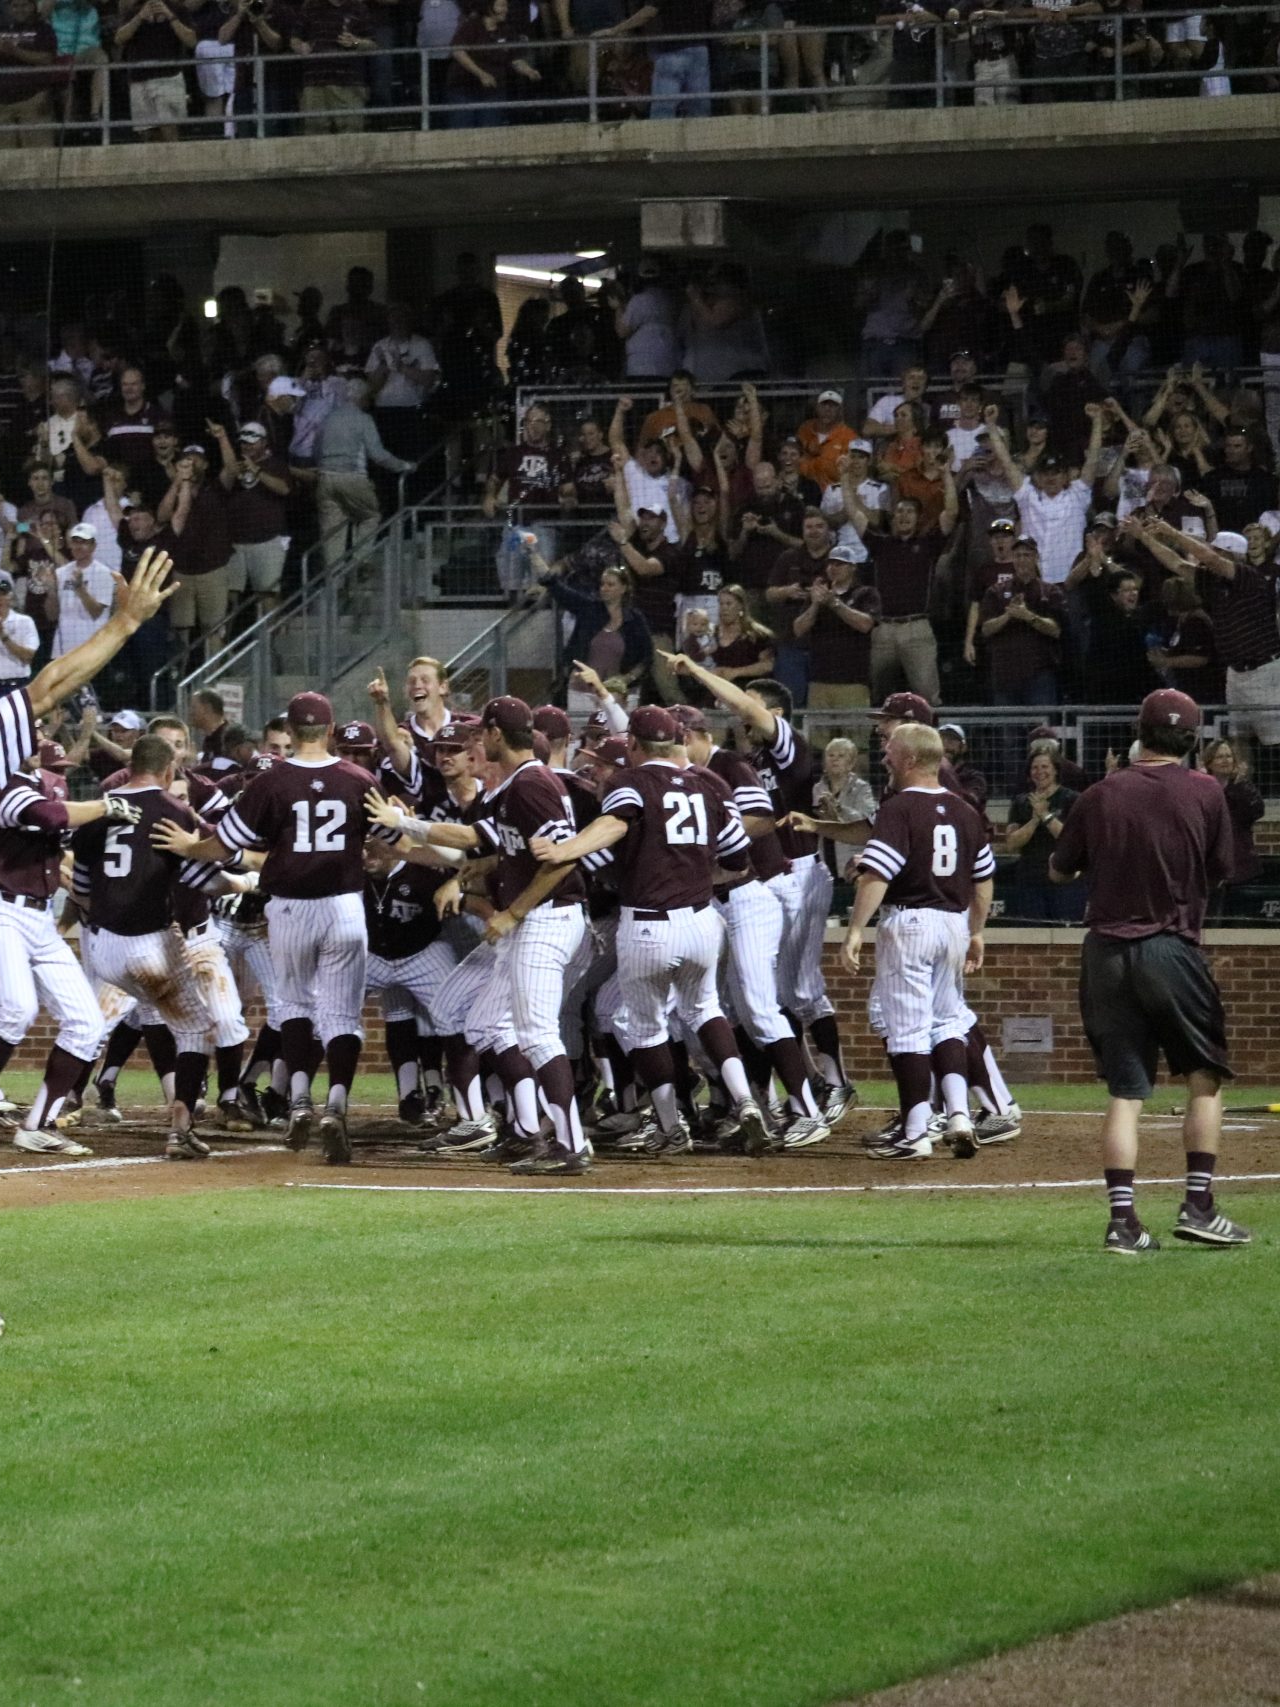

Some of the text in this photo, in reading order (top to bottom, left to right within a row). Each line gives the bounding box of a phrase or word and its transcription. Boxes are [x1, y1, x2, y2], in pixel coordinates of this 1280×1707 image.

[291, 799, 348, 853] 12
[662, 791, 708, 846] 21
[103, 824, 135, 878] 5
[931, 824, 957, 877] 8
